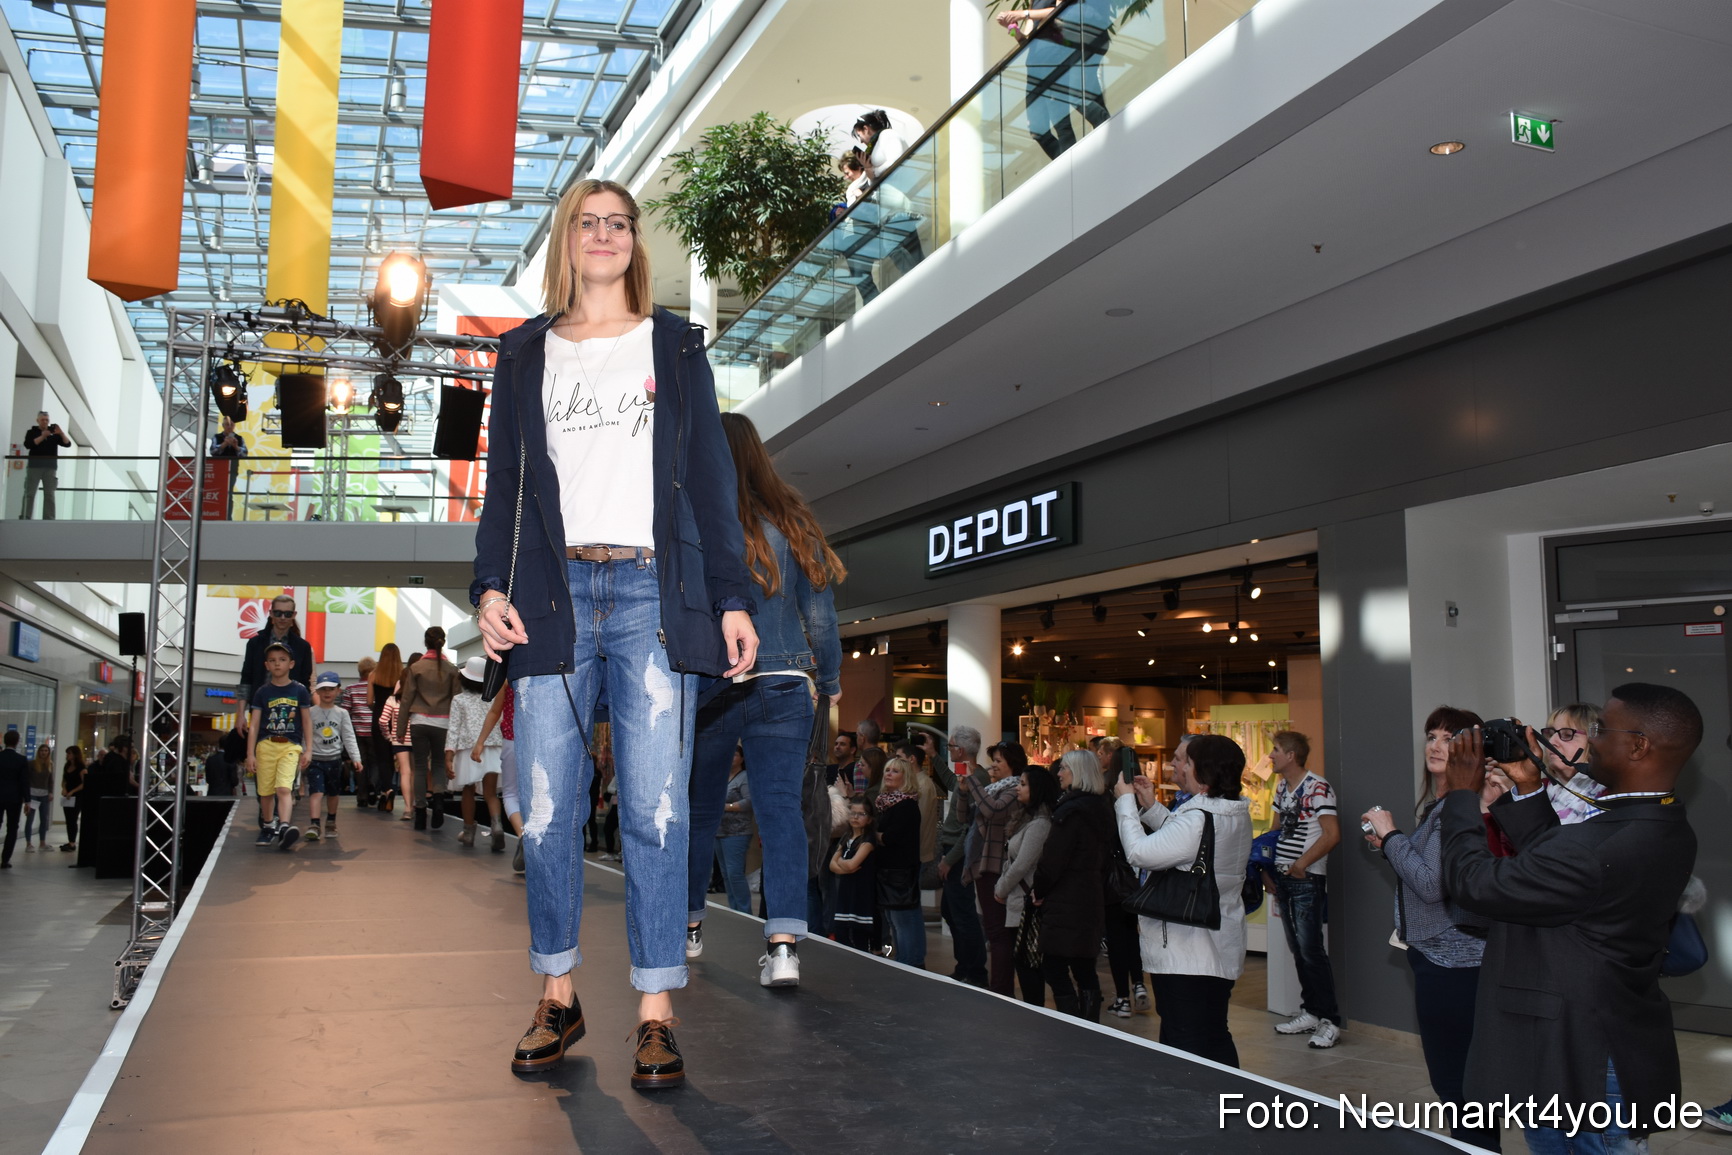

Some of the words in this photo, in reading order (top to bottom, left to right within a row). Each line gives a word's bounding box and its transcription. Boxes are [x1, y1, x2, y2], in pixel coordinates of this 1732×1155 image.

[589, 420, 620, 430] AWEOME
[929, 490, 1058, 566] DEPOT
[893, 697, 950, 714] EPOT
